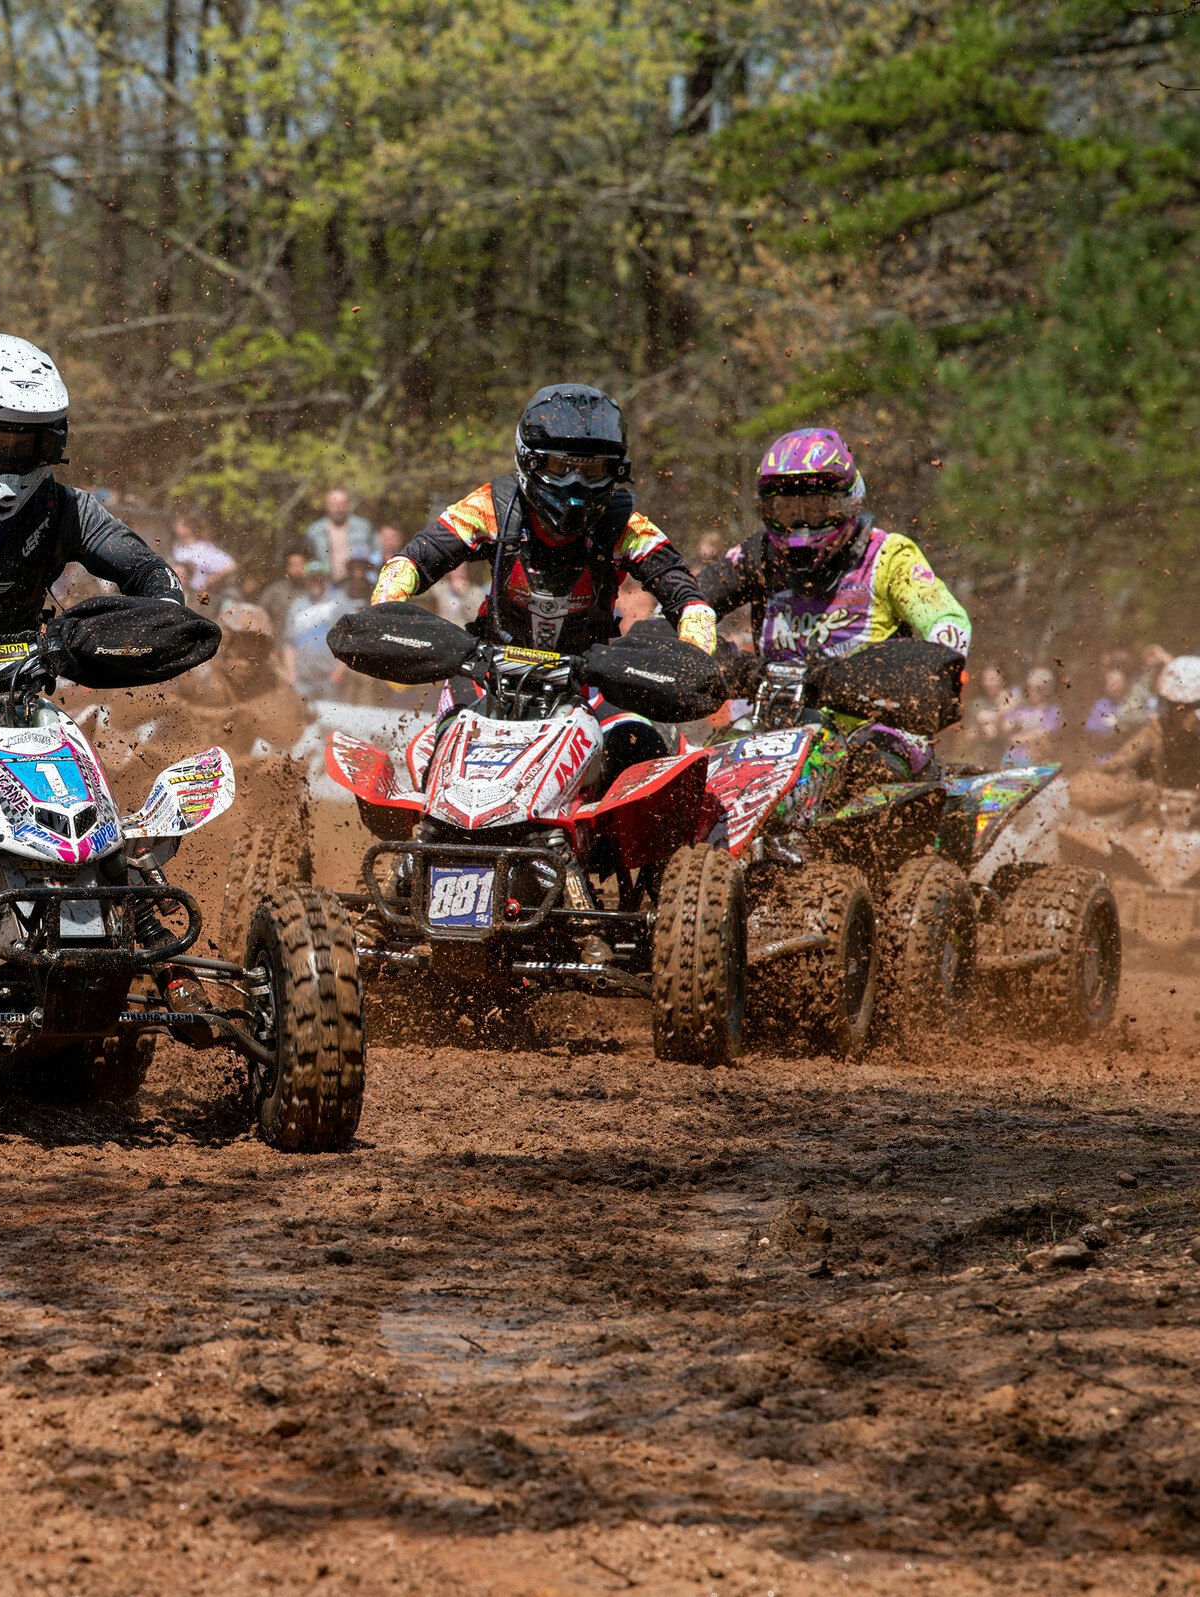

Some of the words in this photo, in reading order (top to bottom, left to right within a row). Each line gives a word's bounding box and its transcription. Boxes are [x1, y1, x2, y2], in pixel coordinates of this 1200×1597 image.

[35, 762, 69, 797] 1
[519, 762, 545, 788] ACTION
[90, 820, 118, 853] HiPer
[428, 870, 495, 919] 881
[119, 1012, 161, 1021] EIXEIRA
